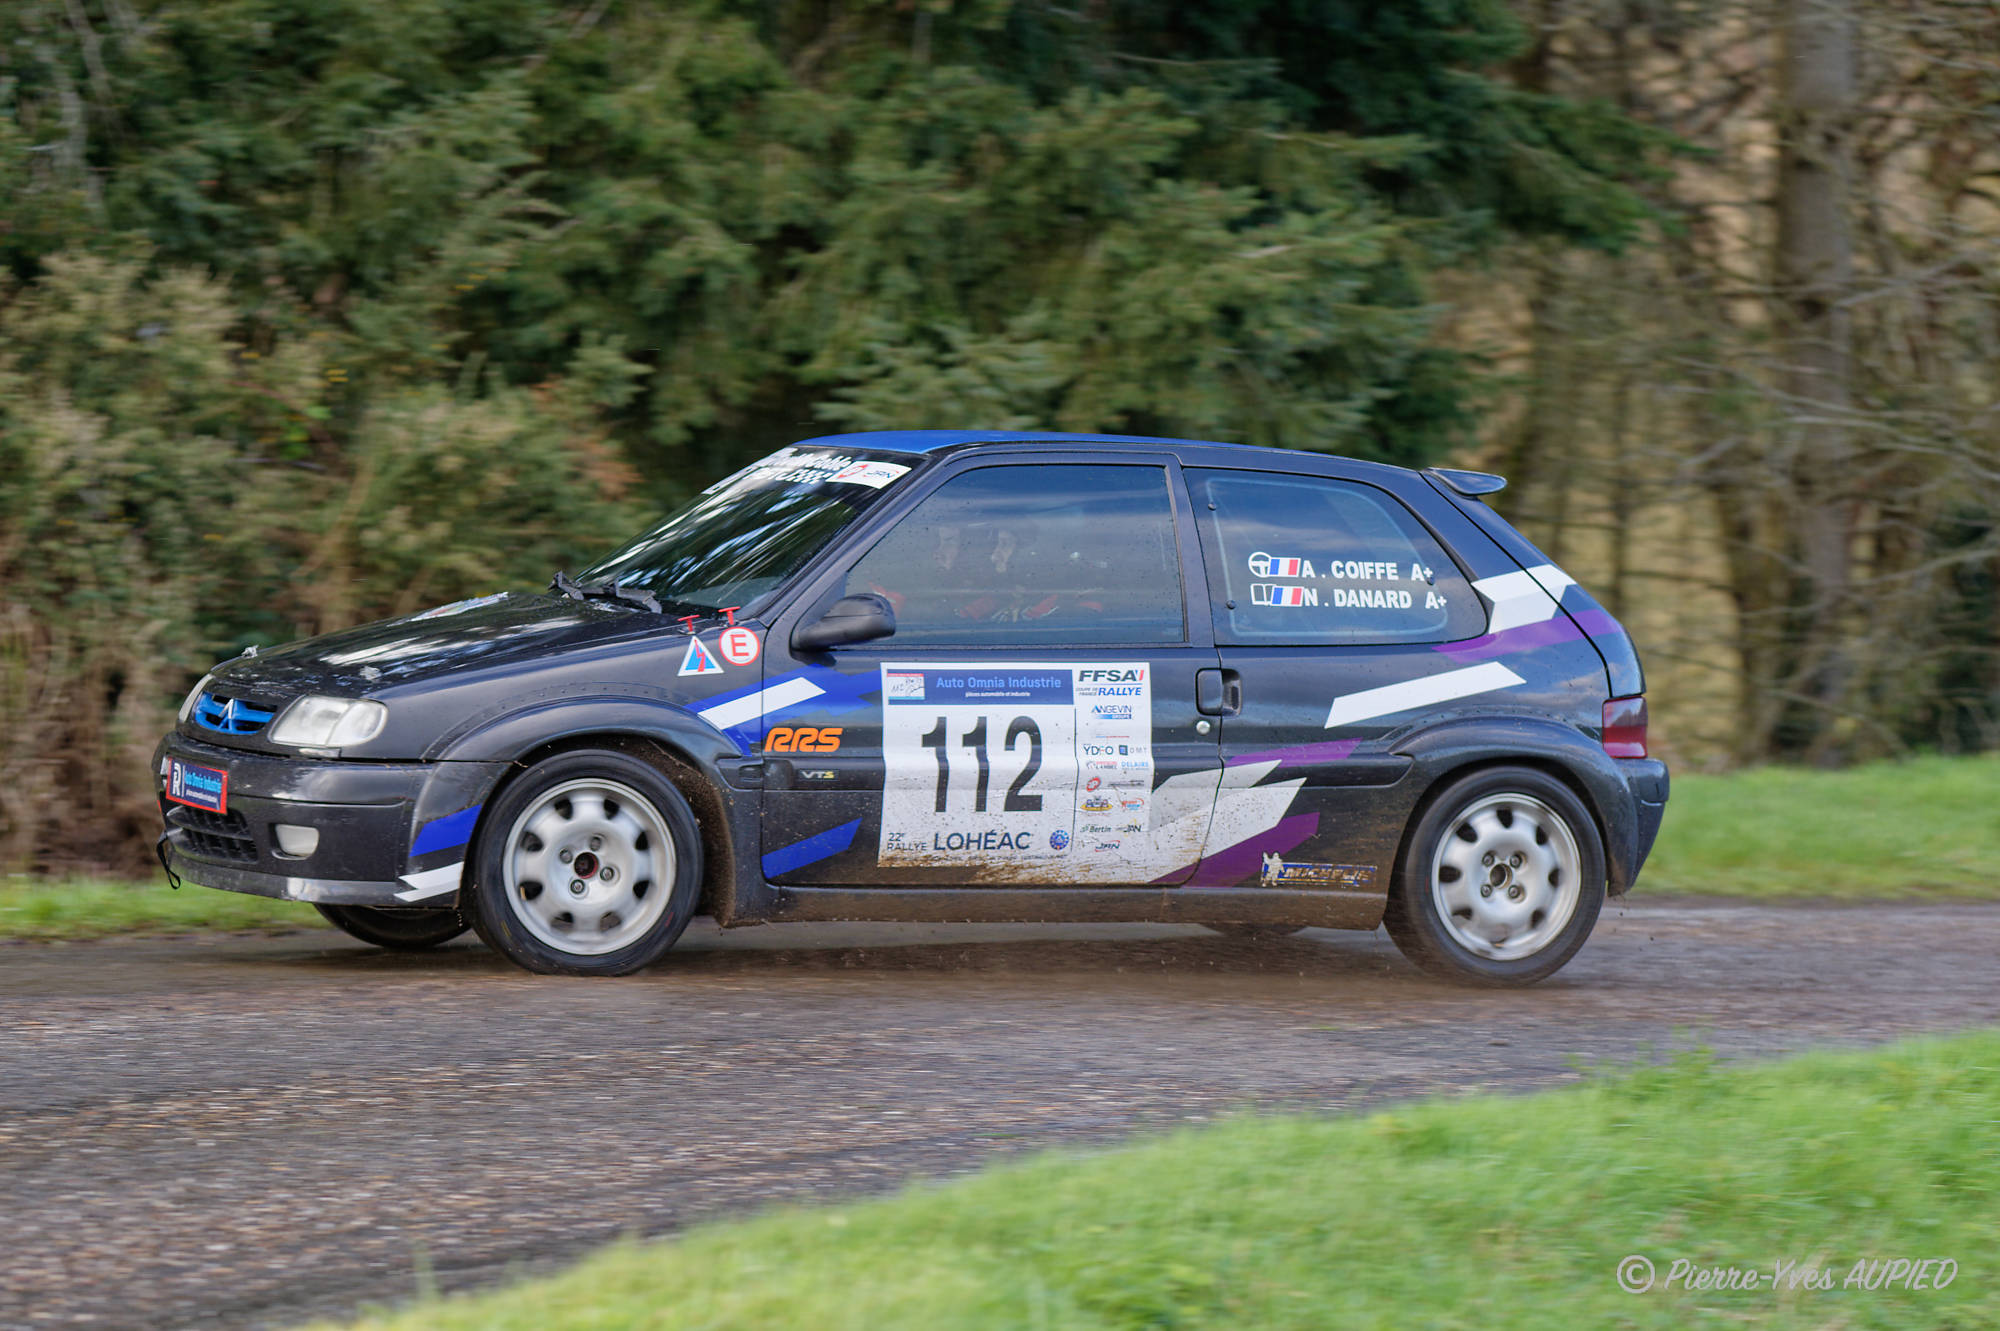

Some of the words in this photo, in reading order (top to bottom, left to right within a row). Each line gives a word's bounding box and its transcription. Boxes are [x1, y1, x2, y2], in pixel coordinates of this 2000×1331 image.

[1331, 560, 1399, 581] COIFFE
[1411, 563, 1433, 582] A+
[1334, 588, 1412, 609] DANARD
[1425, 591, 1447, 610] A+
[730, 633, 749, 657] E
[936, 676, 964, 688] Auto
[968, 676, 1005, 688] Omnia
[1009, 676, 1062, 688] Industrie
[1079, 669, 1137, 682] FFSA
[1098, 687, 1142, 696] RALLYE
[1091, 705, 1131, 713] ANGEVIN
[764, 727, 843, 753] RRS
[802, 770, 835, 779] VTS
[921, 715, 1043, 813] 112
[887, 842, 928, 851] RALLYE
[933, 829, 1031, 851] LOHÉAC
